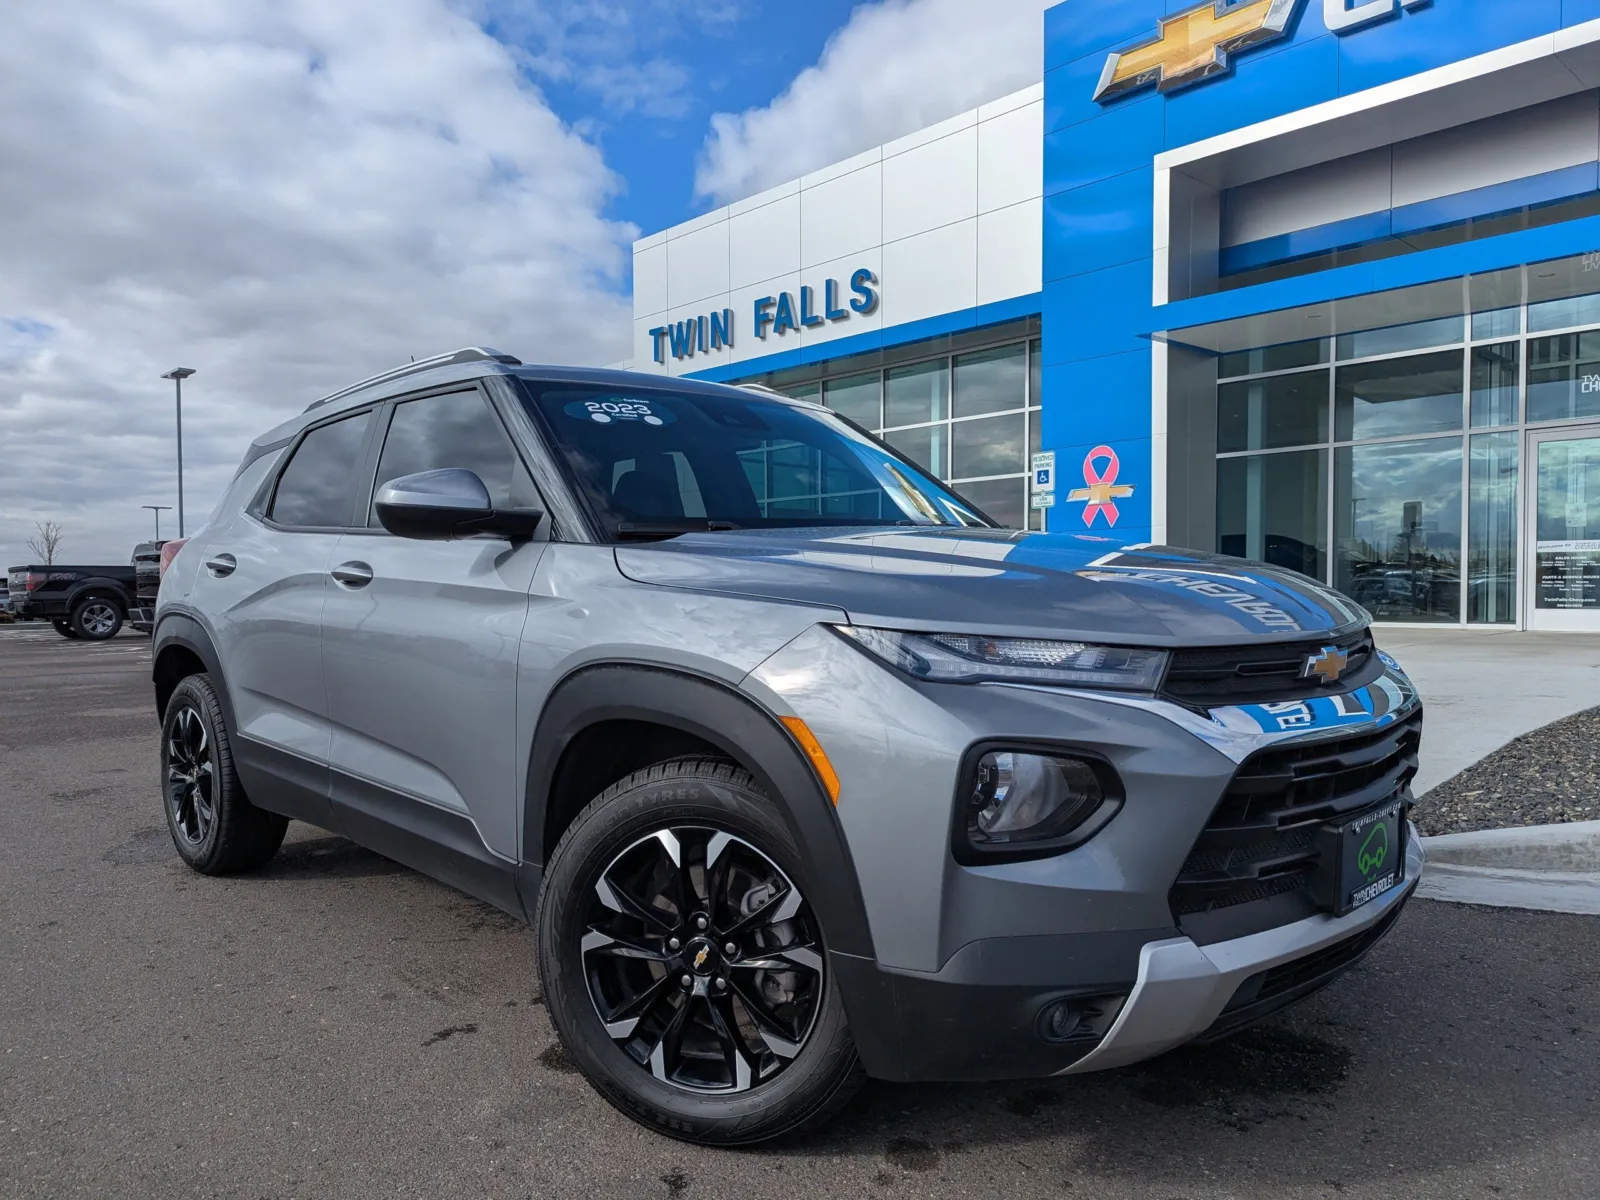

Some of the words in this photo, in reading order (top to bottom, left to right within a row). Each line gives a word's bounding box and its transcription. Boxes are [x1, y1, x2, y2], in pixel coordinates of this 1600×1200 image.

[649, 308, 734, 364] TWIN
[754, 268, 880, 341] FALLS
[1582, 381, 1600, 393] CH
[585, 402, 652, 415] 2023
[634, 788, 700, 808] TYRES
[1365, 873, 1394, 901] CHEVROLET
